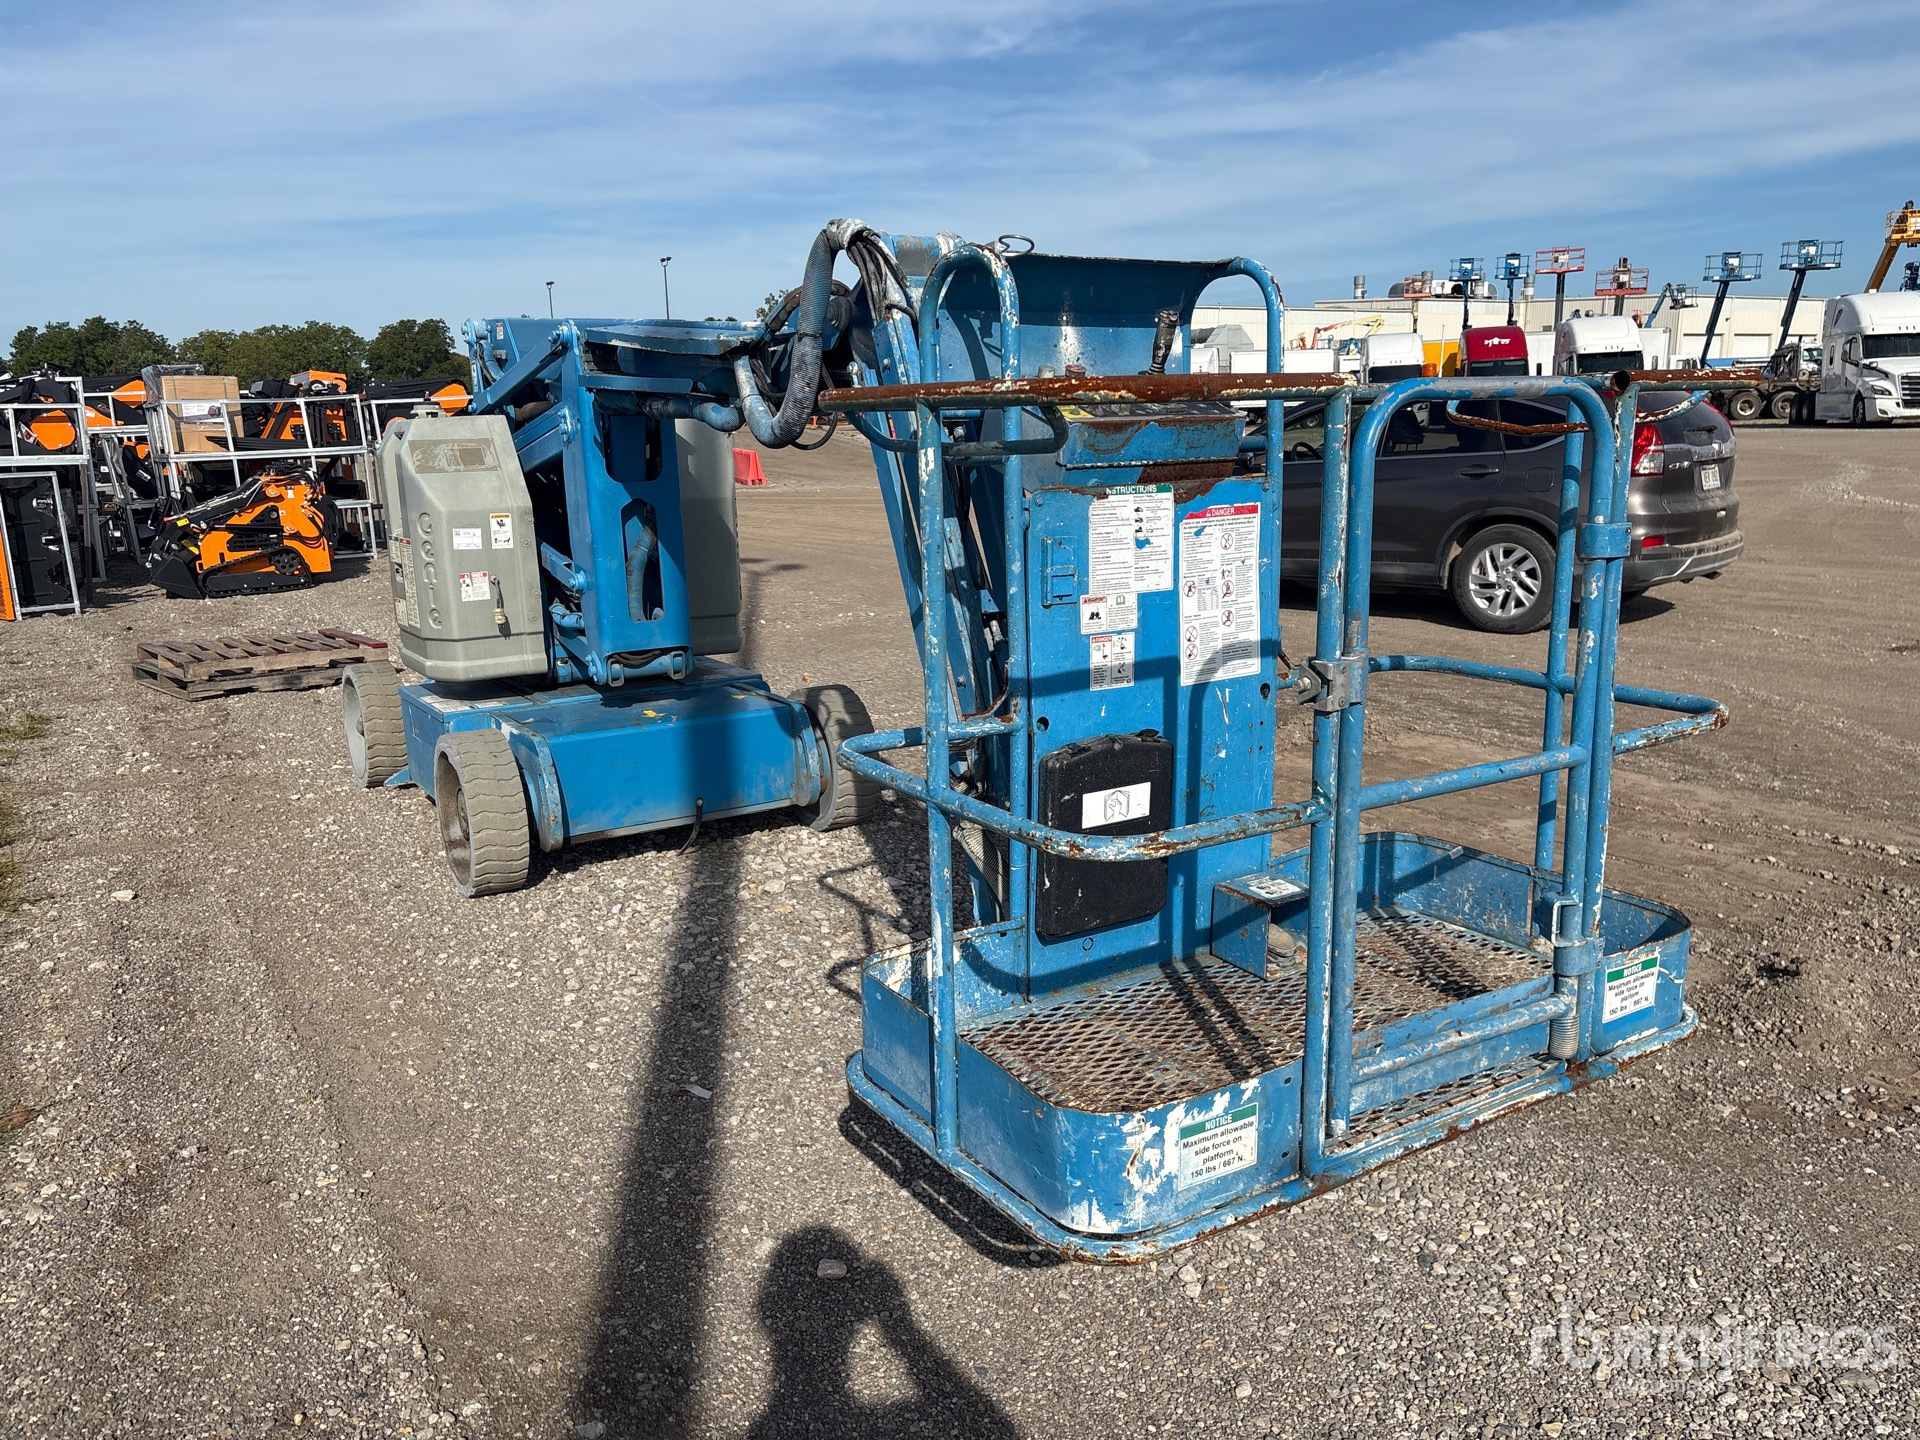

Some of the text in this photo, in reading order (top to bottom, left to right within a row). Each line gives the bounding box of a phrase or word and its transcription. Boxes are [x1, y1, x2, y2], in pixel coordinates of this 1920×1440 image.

[1106, 485, 1157, 495] NSTRUCTIONS
[1211, 507, 1235, 517] DANGER
[1623, 963, 1643, 978] NOTICE
[1608, 971, 1655, 992] Maximum allowable
[1614, 989, 1625, 997] side
[1626, 984, 1638, 993] force
[1620, 990, 1640, 1004] platform
[1609, 1007, 1618, 1016] 150
[1205, 1113, 1233, 1131] NOTICE
[1182, 1120, 1255, 1150] Maximum allowable
[1194, 1135, 1242, 1156] side force on
[1202, 1149, 1234, 1166] platform
[1191, 1168, 1204, 1179] 150
[1205, 1164, 1217, 1174] lbs
[1222, 1157, 1236, 1168] 667
[1237, 1154, 1244, 1162] N
